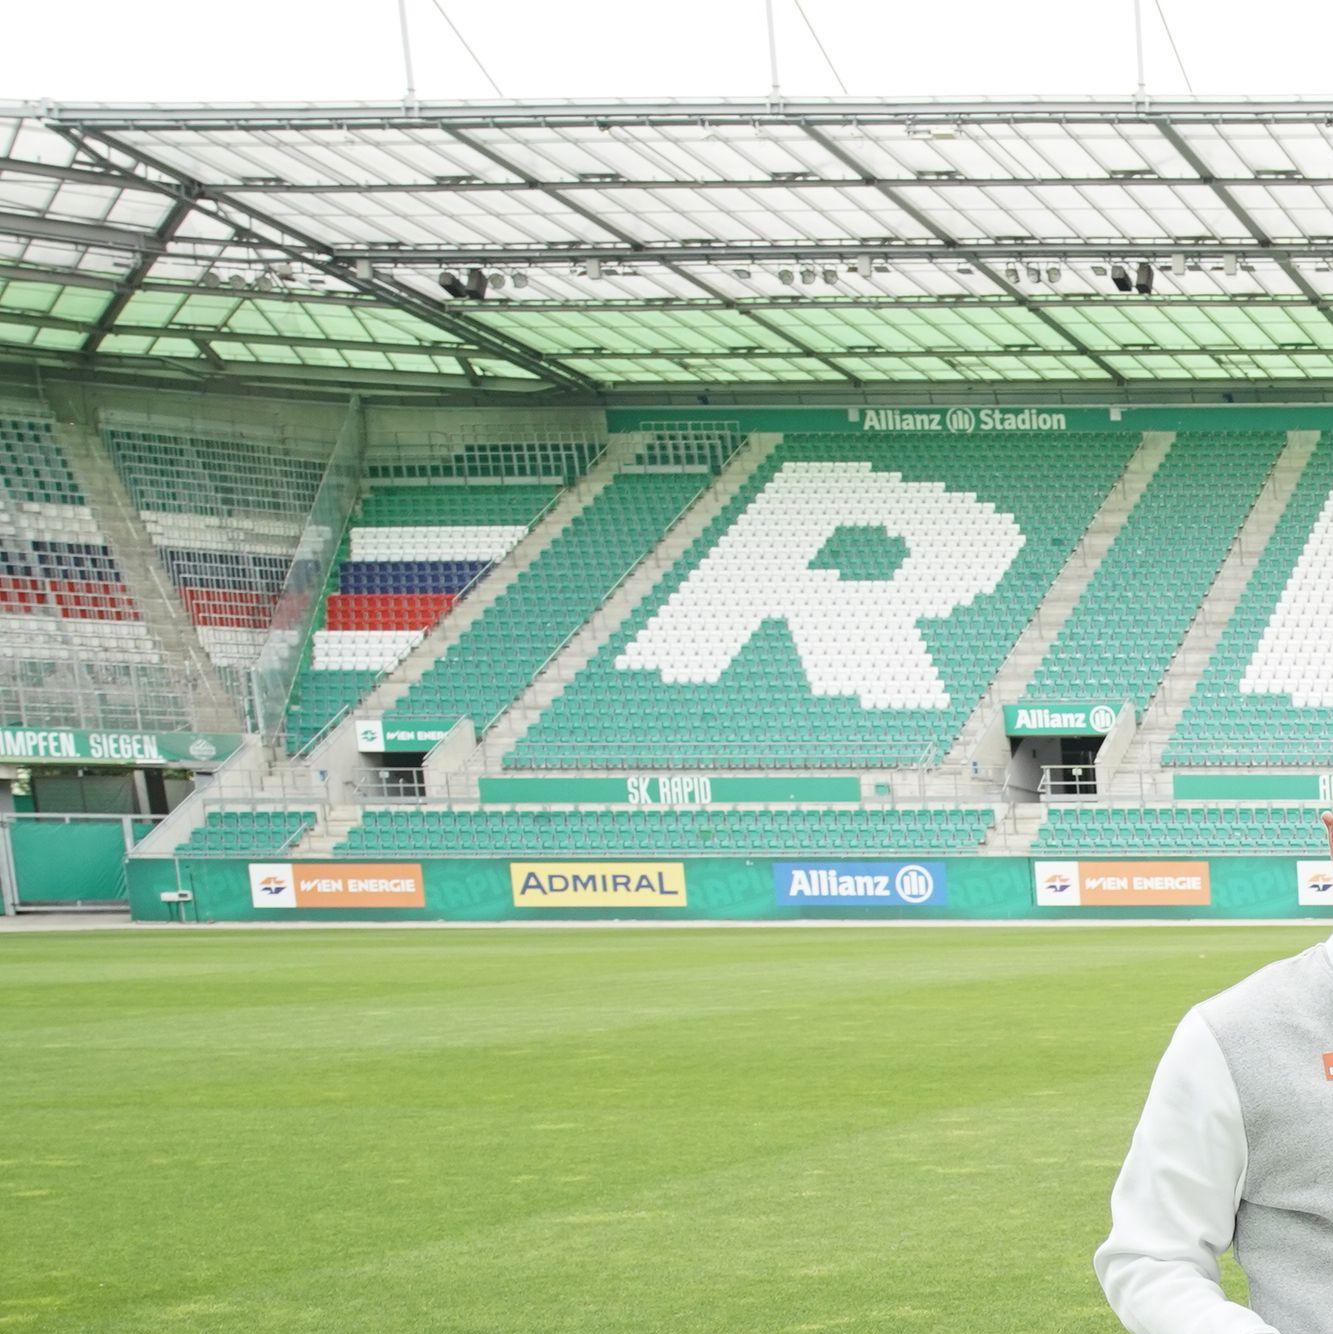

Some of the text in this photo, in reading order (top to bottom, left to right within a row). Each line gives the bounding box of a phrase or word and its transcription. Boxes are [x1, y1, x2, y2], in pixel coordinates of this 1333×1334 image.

[863, 408, 1066, 430] Allianz Stadion
[1014, 709, 1086, 729] Allianz
[89, 734, 163, 760] SIEGEN.
[627, 776, 711, 804] SK RAPID
[300, 879, 416, 893] WIEN ENERGIE
[520, 871, 678, 895] ADMIRAL
[789, 869, 890, 896] Allianz
[1085, 876, 1201, 890] WIEN ENERGIE
